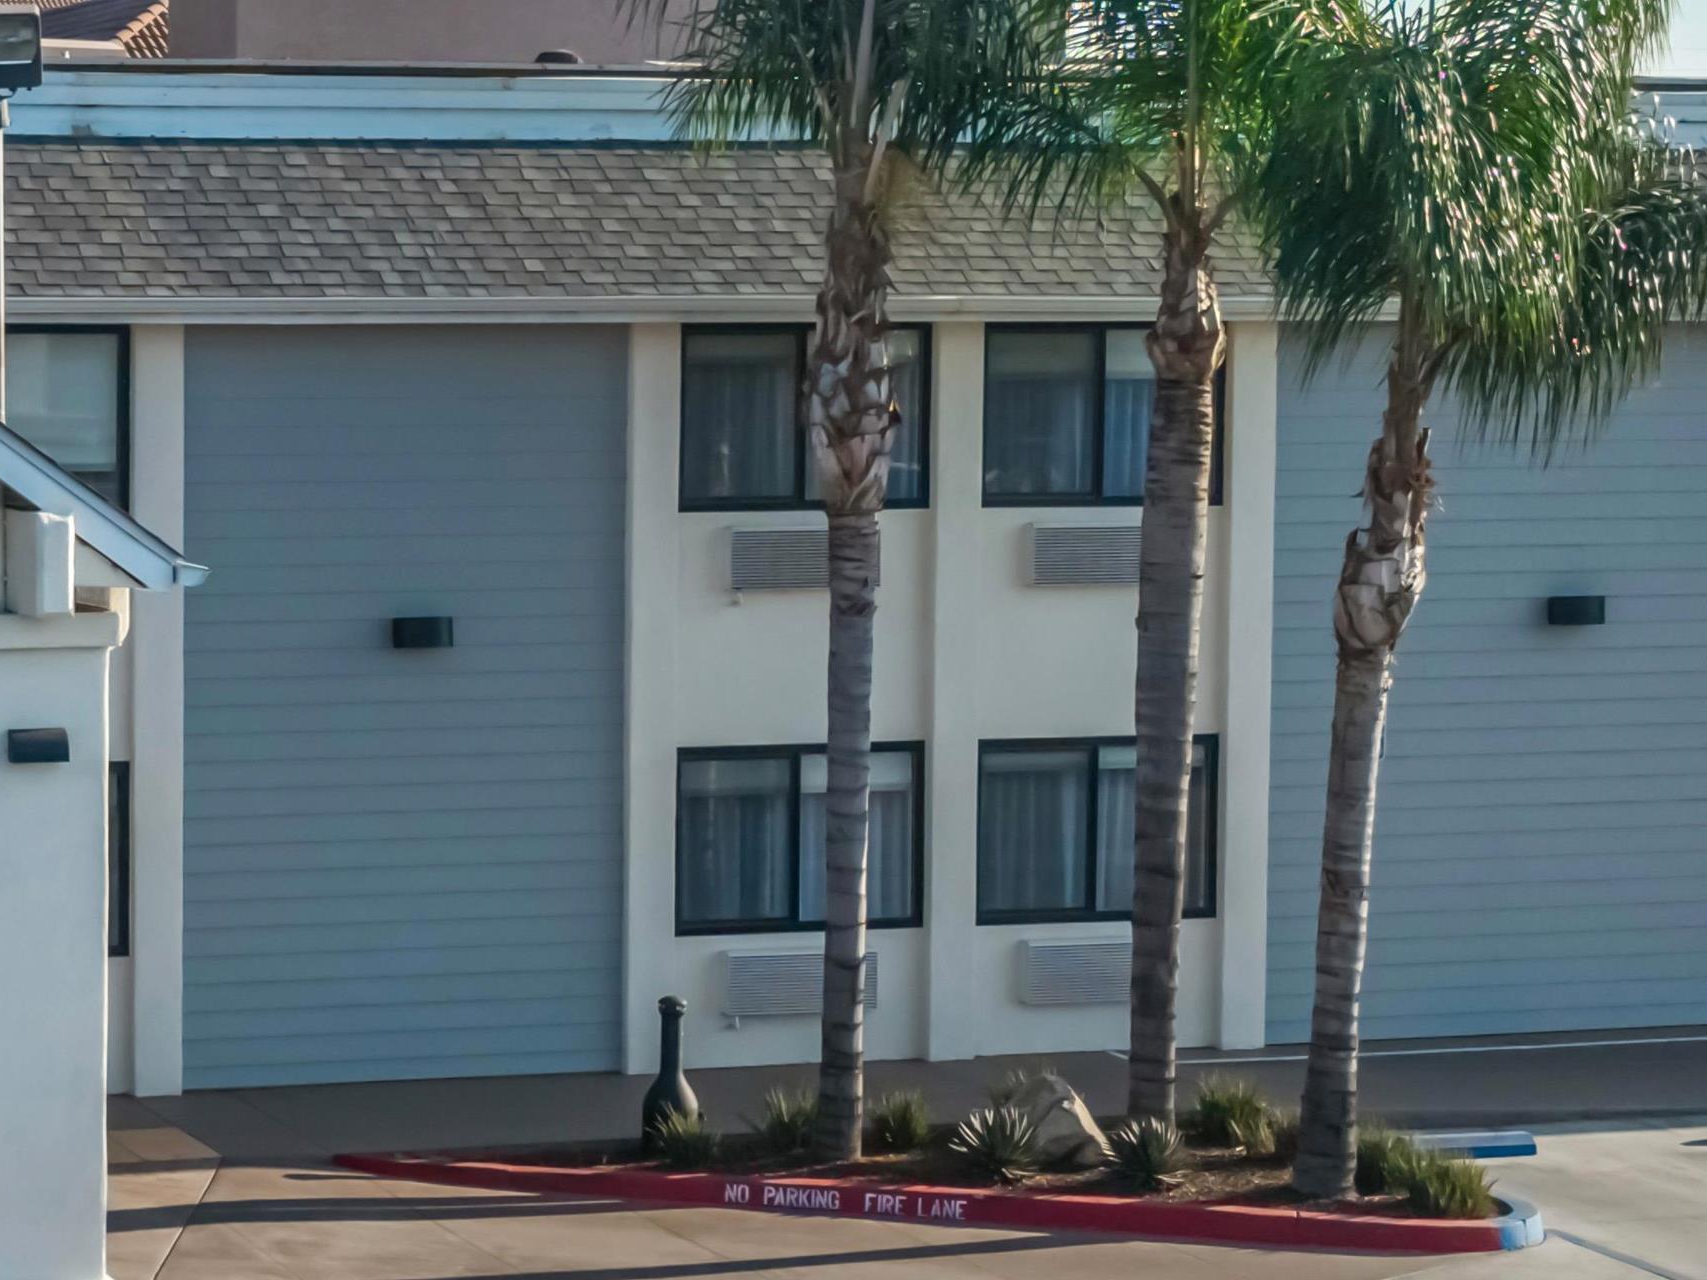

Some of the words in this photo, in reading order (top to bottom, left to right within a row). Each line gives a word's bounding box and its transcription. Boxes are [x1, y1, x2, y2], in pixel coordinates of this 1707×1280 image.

[725, 1183, 750, 1204] NO
[763, 1185, 841, 1210] PARKING
[865, 1192, 908, 1216] FIRE
[918, 1197, 968, 1220] LANE
